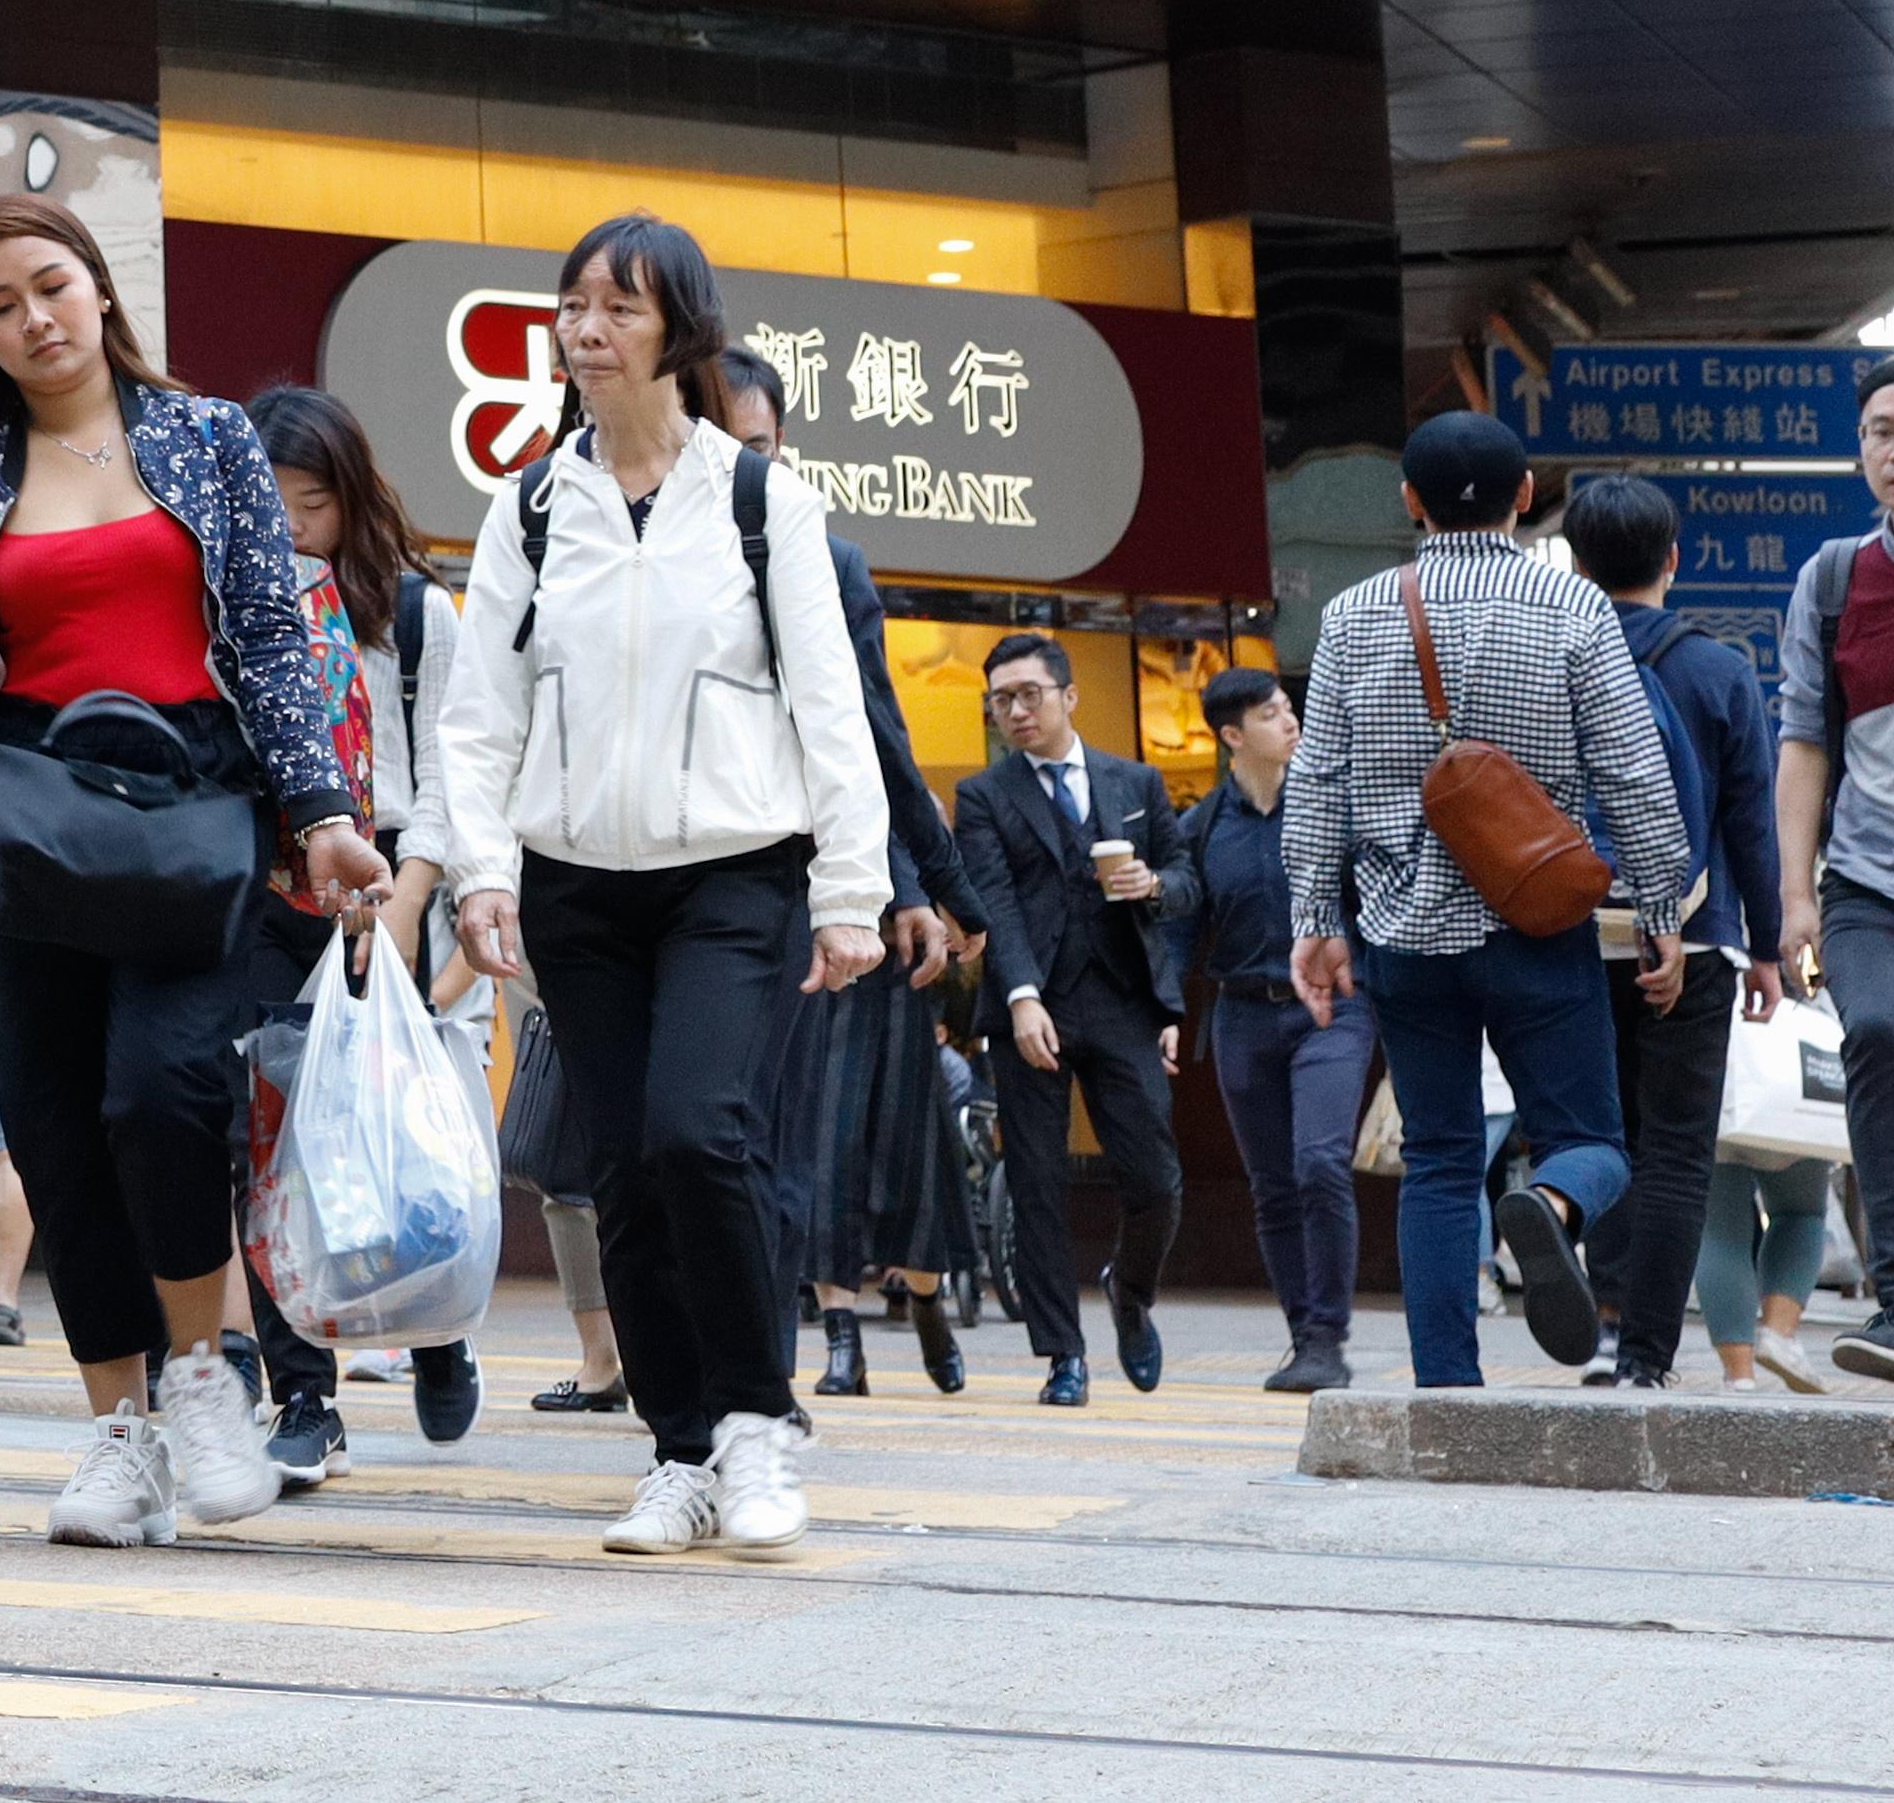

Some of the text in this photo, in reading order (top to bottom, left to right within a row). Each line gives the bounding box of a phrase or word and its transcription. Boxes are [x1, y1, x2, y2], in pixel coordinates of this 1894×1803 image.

[1566, 358, 1680, 392] Airport
[1702, 357, 1833, 393] Express
[780, 446, 892, 517] ING
[1688, 486, 1827, 515] Kowloon
[1695, 533, 1788, 573] 九龍
